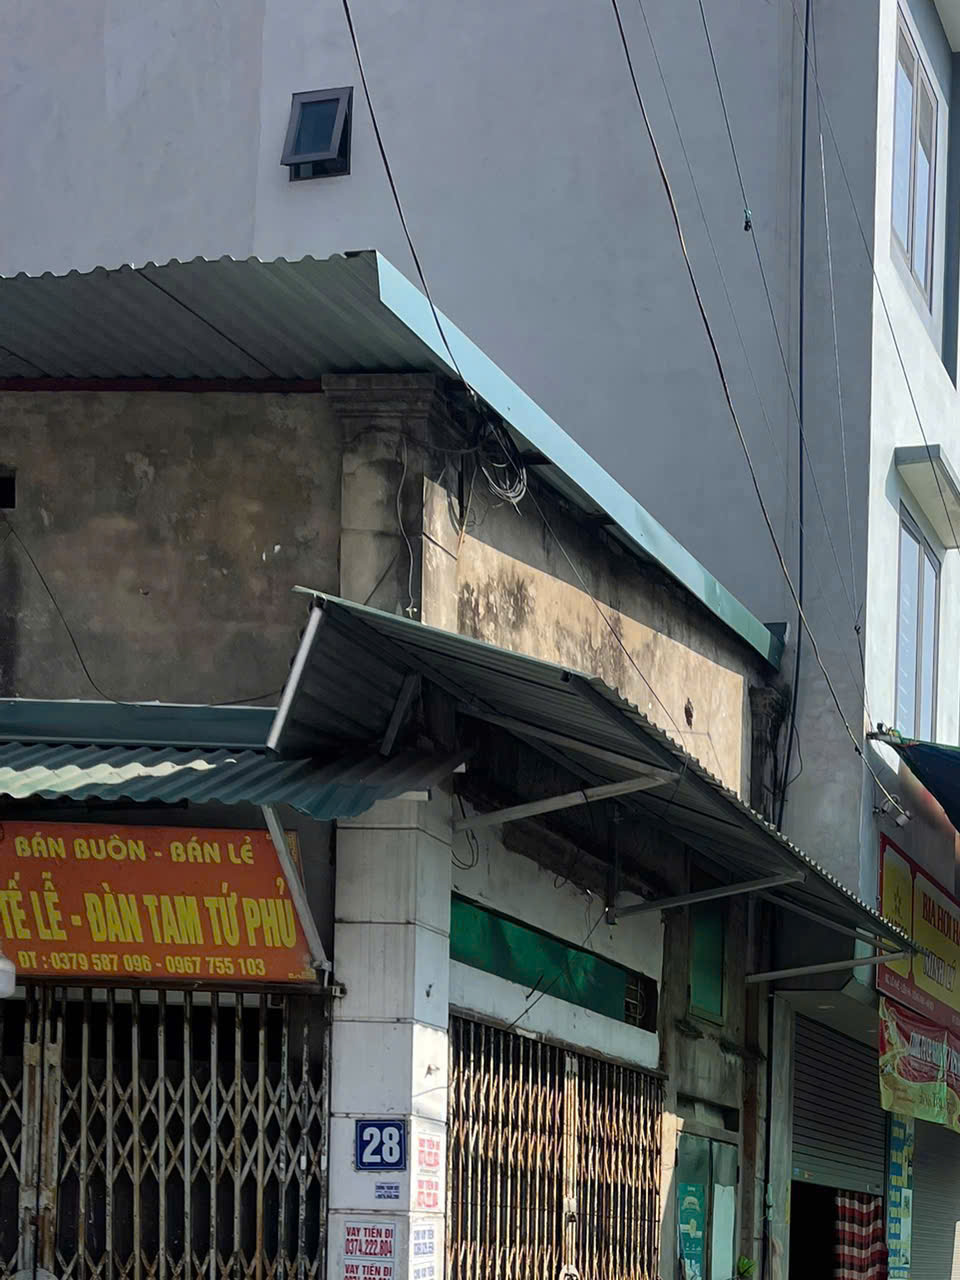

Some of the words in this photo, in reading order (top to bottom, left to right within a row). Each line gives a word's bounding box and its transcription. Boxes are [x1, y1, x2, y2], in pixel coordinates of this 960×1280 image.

[14, 832, 67, 859] BÁN
[73, 834, 147, 861] BUÔN
[169, 836, 222, 864] BÁN
[228, 836, 255, 865] LẺ
[29, 871, 68, 941] LỄ
[83, 881, 145, 944] ĐÀN
[143, 894, 204, 945] TAM
[204, 881, 241, 947] TỨ
[242, 876, 298, 949] PHỦ
[50, 952, 89, 971] 0379
[91, 953, 119, 972] 587
[124, 955, 153, 973] 096
[165, 955, 201, 974] 0967
[205, 956, 235, 976] 755
[237, 958, 267, 977] 103
[362, 1126, 401, 1164] 28
[346, 1226, 361, 1238] VAY
[384, 1228, 394, 1239] ĐI
[344, 1264, 360, 1275] VAY
